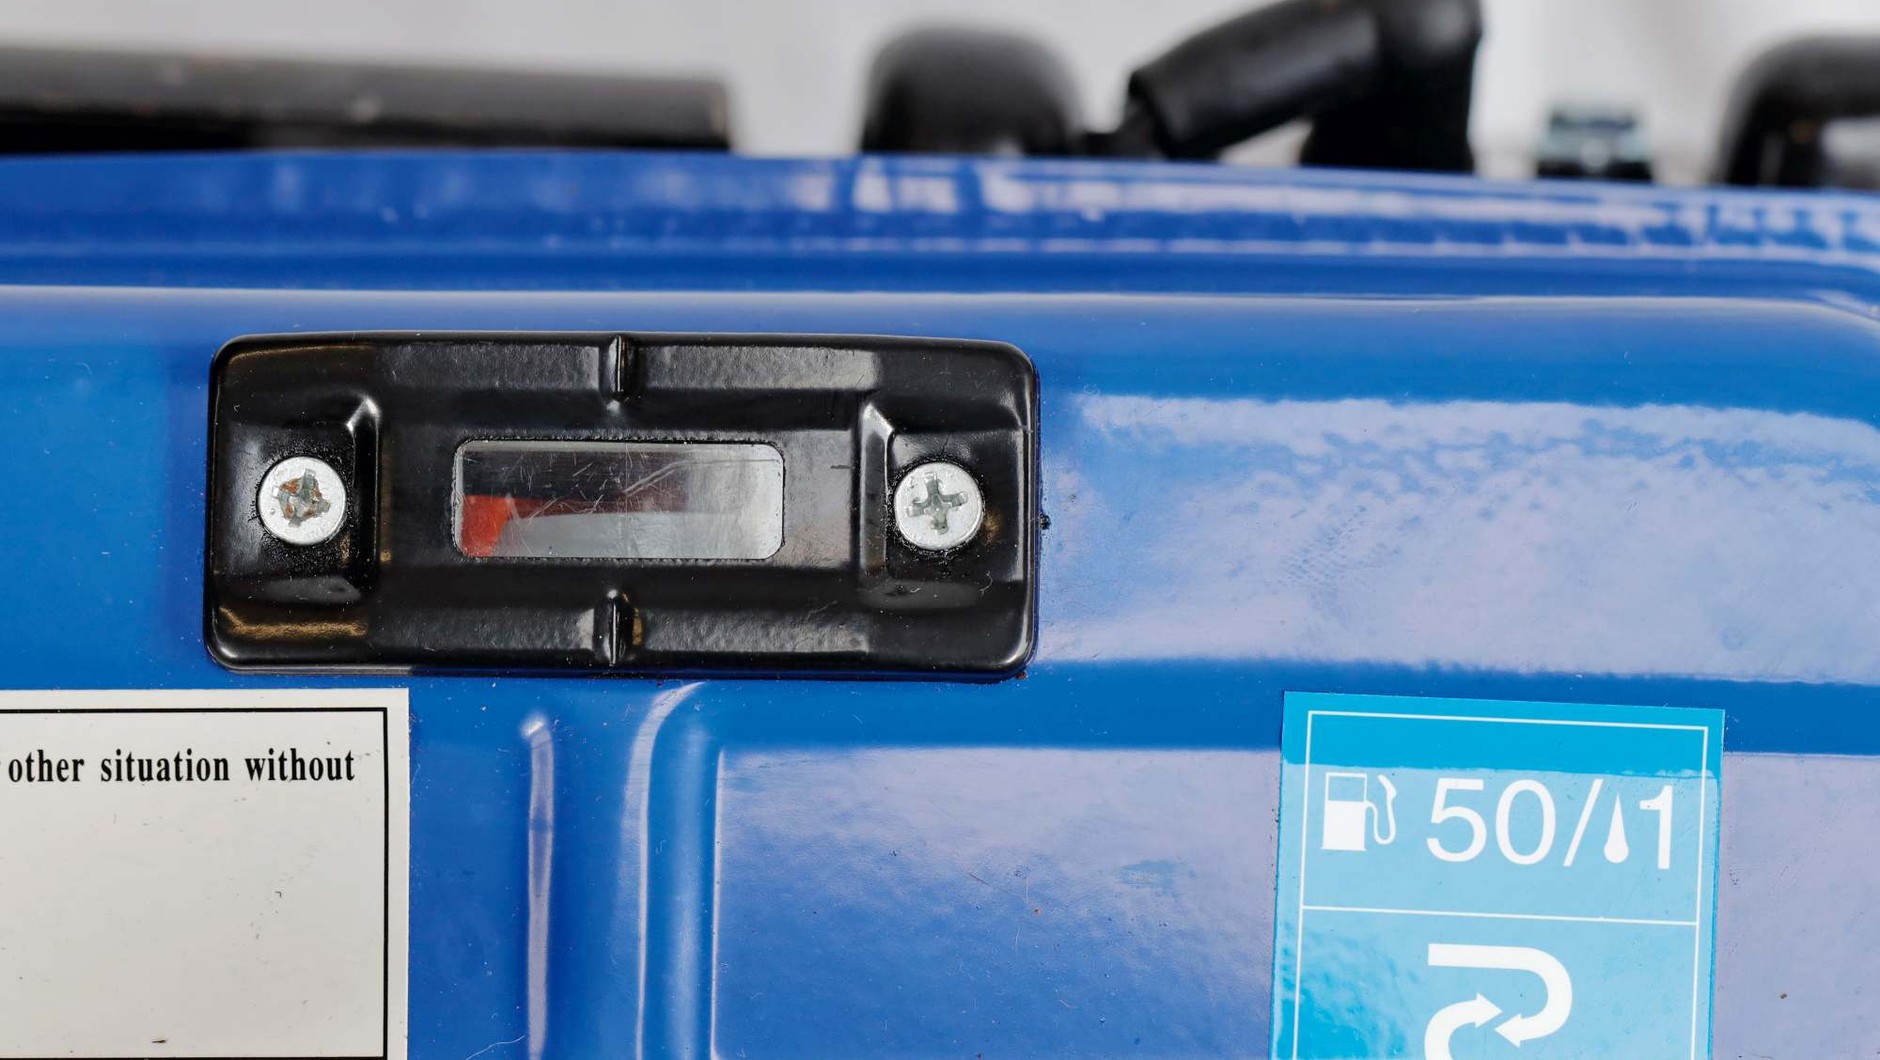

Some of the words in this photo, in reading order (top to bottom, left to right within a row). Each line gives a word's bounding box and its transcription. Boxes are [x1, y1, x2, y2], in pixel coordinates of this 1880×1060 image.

[8, 749, 85, 782] other
[100, 748, 230, 782] situation
[245, 748, 355, 782] without
